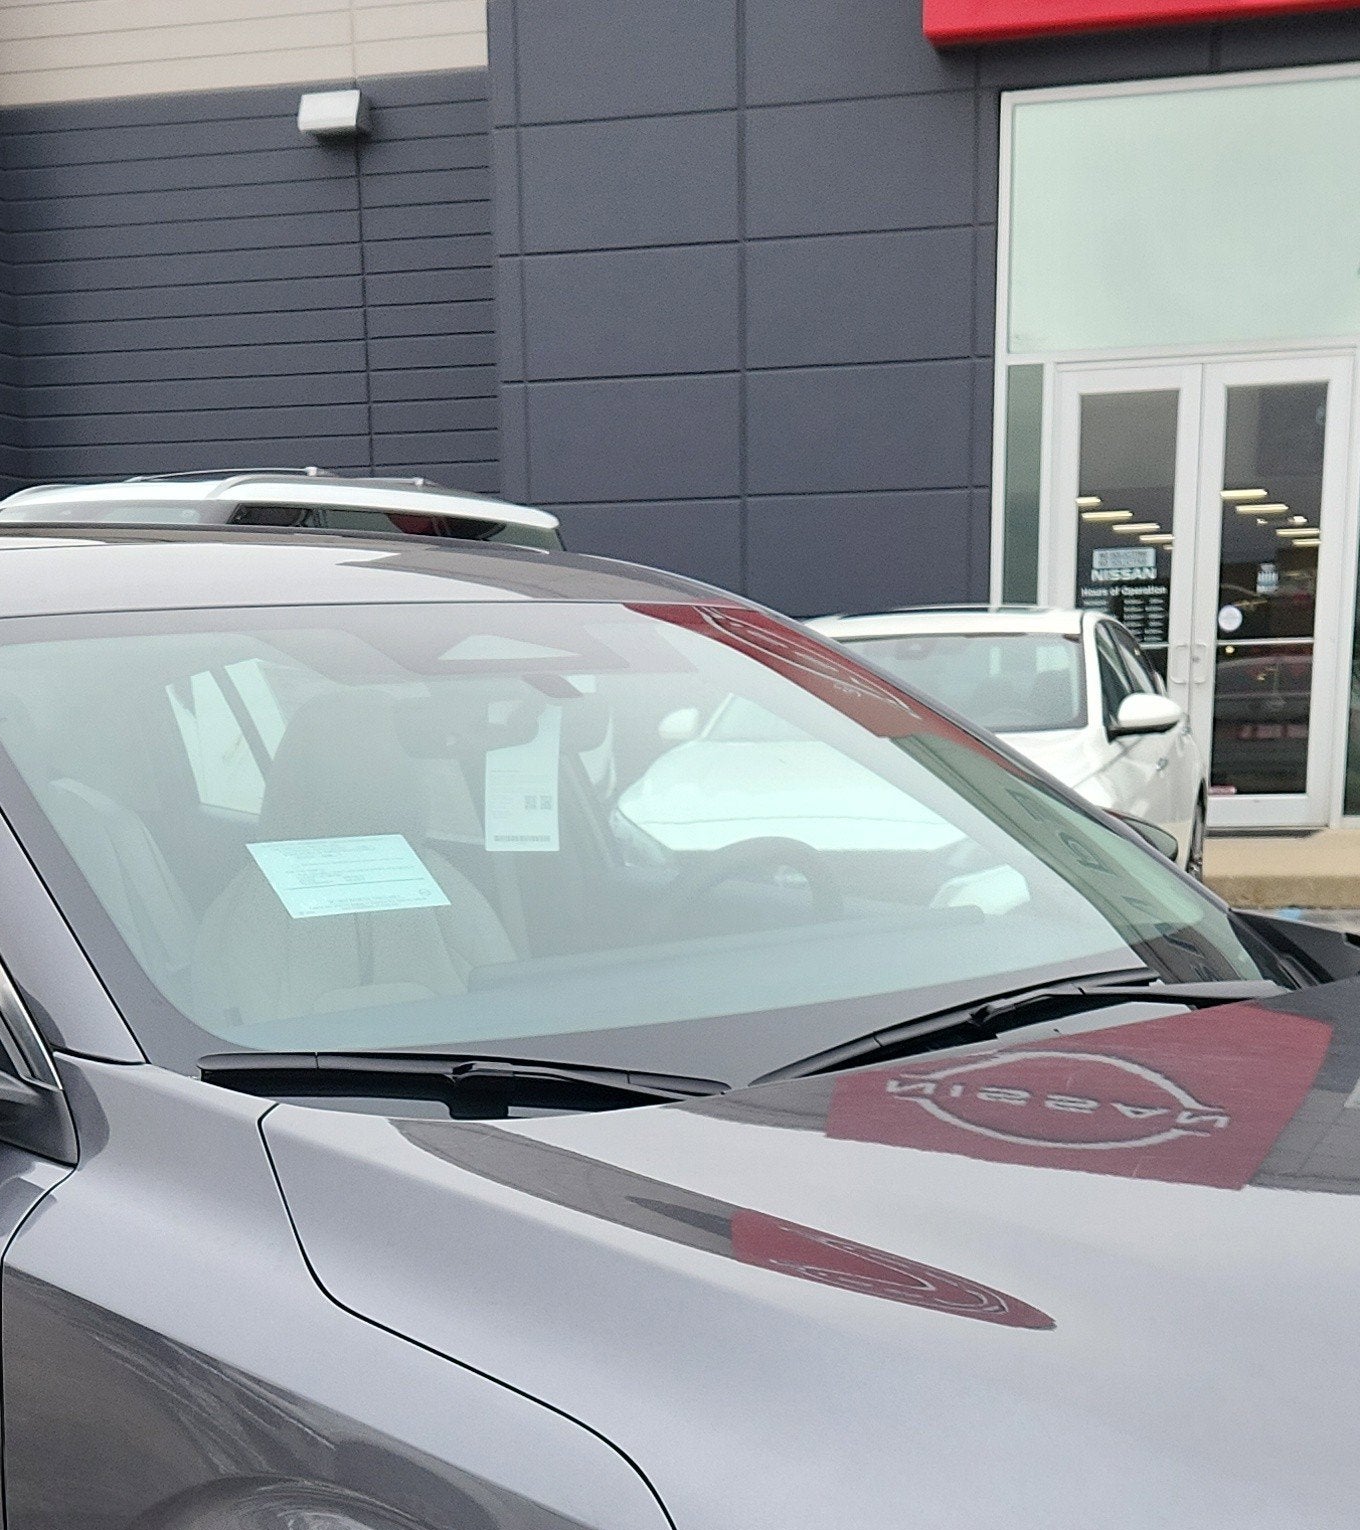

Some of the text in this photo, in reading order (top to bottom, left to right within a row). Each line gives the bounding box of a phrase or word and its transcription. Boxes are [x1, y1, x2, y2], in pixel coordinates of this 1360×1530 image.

[1091, 568, 1157, 582] NISSAN
[1081, 586, 1168, 597] Hours of Operation
